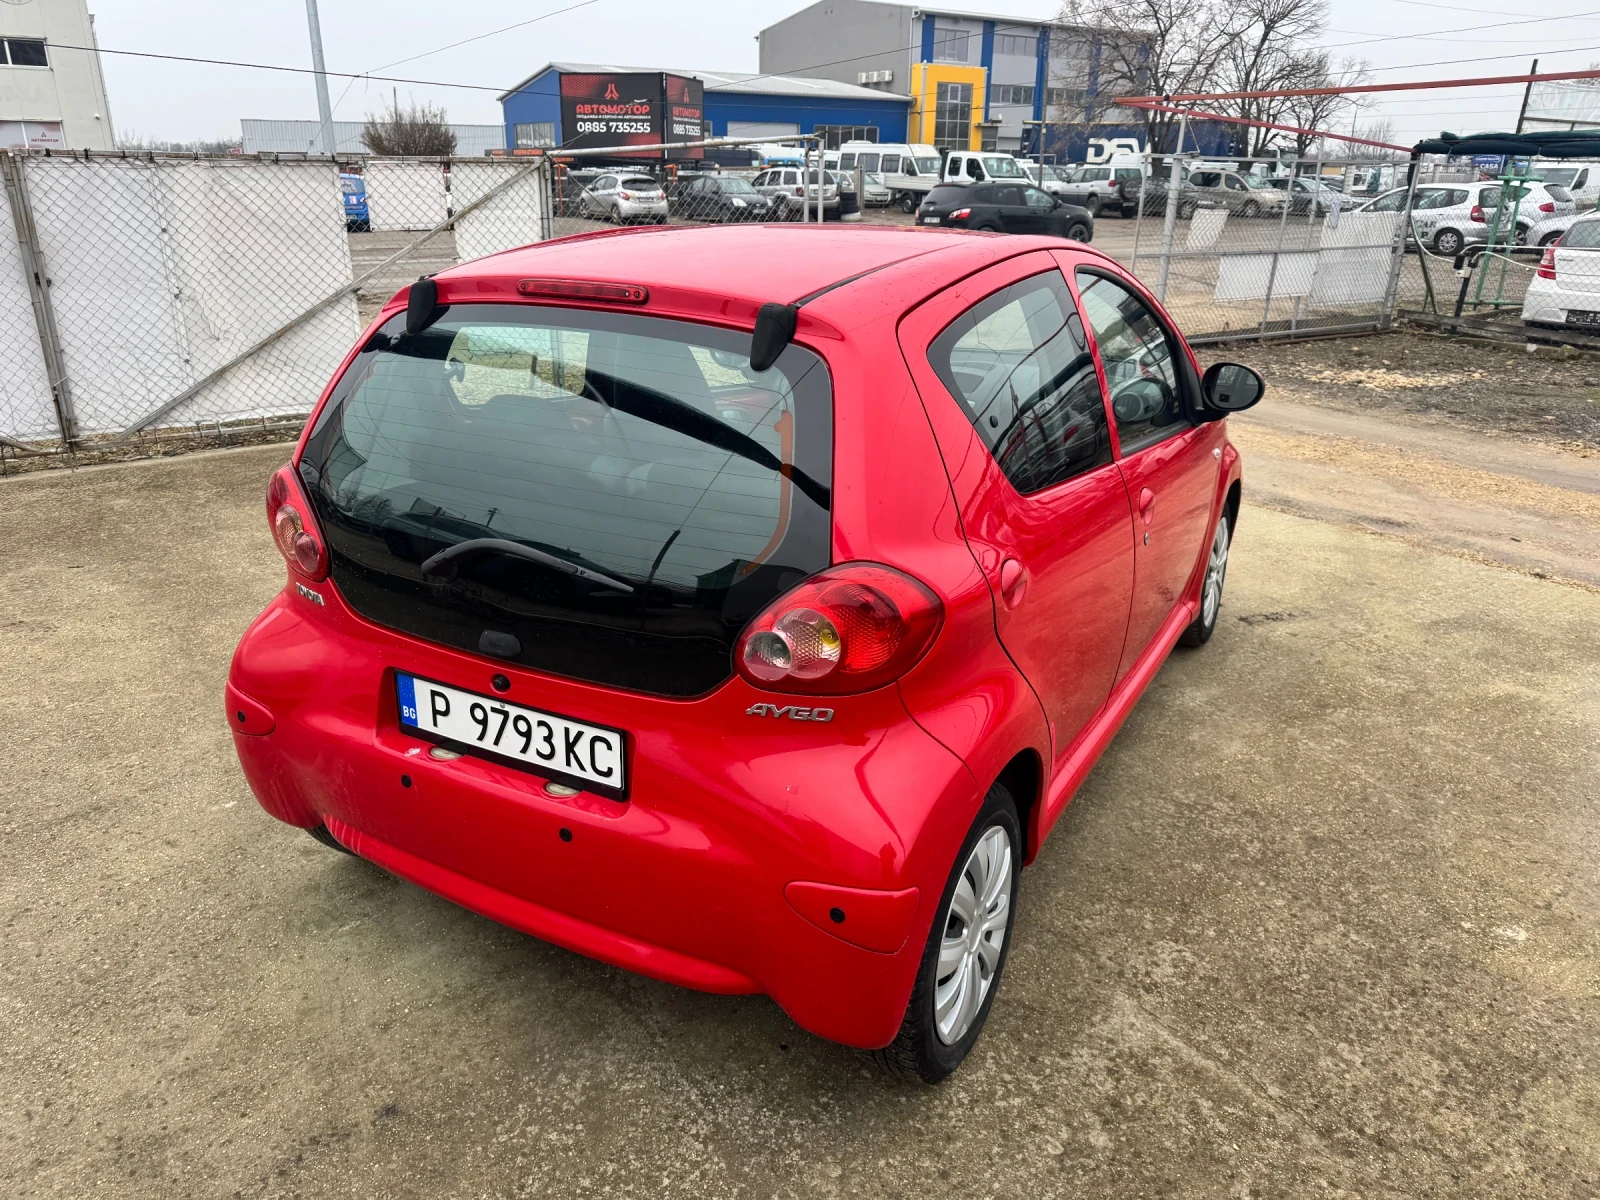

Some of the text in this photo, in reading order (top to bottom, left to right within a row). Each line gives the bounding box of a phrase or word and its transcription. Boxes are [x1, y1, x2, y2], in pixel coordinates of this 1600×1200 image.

[576, 104, 650, 114] АВТОМОТОР
[577, 121, 651, 133] 0885 735255
[295, 582, 325, 607] TOYOTA
[402, 705, 416, 720] BG
[745, 702, 835, 722] AYGO
